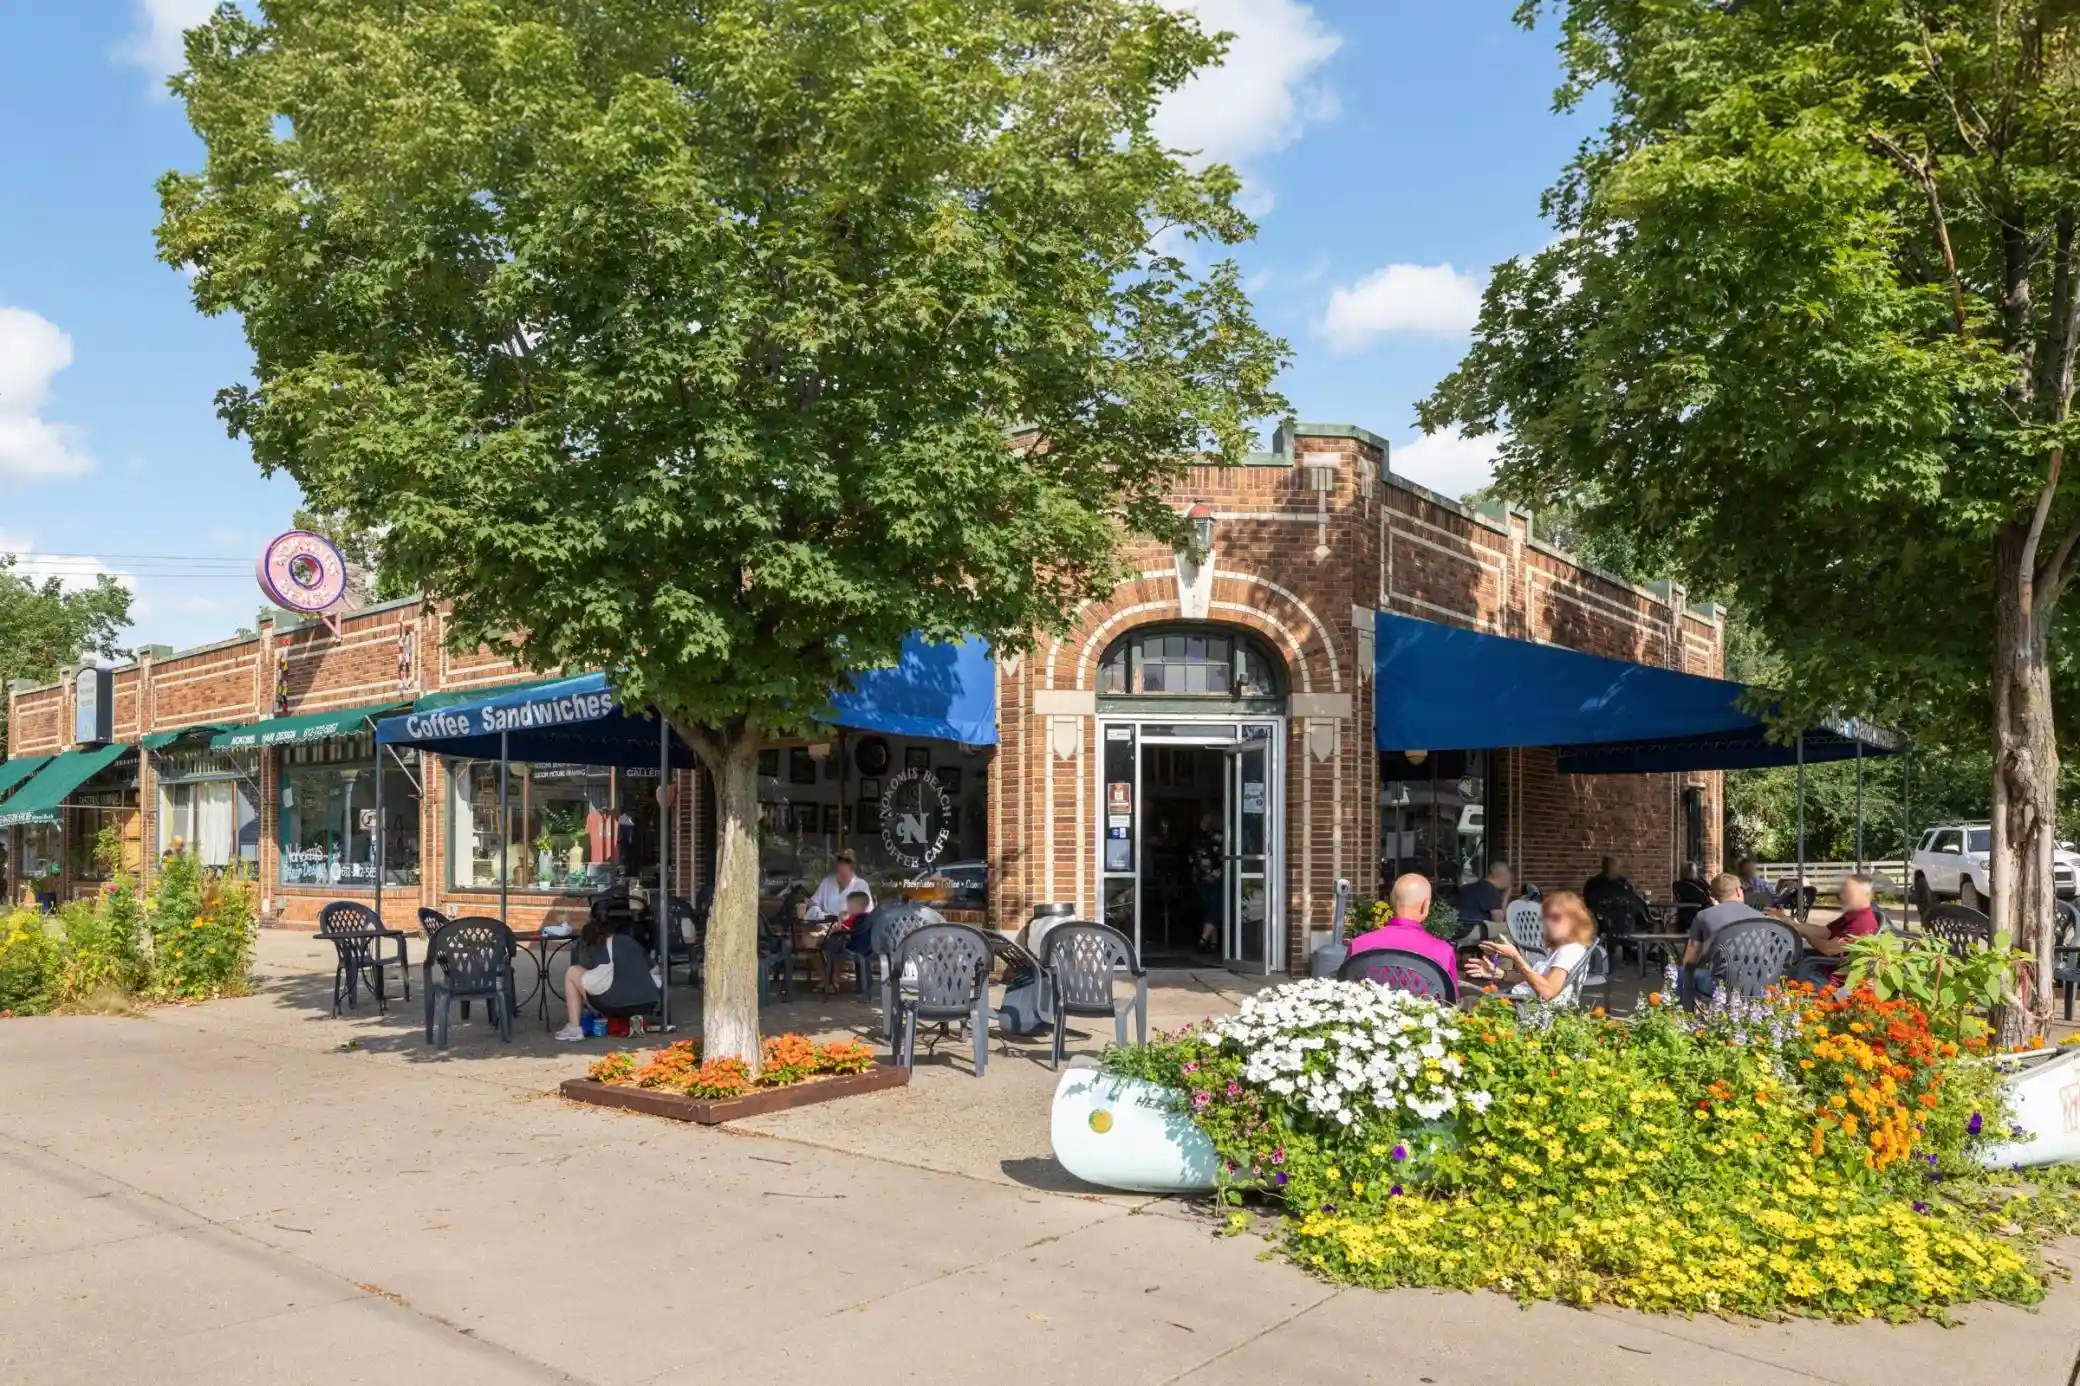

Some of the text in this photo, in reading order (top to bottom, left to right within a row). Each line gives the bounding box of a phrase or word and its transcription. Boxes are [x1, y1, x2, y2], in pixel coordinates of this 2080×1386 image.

[406, 692, 613, 738] Coffee Sandwiches
[626, 769, 661, 777] GALLER
[880, 767, 951, 818] NOKOMIS BEACH
[882, 828, 949, 868] COFFEE CAFE
